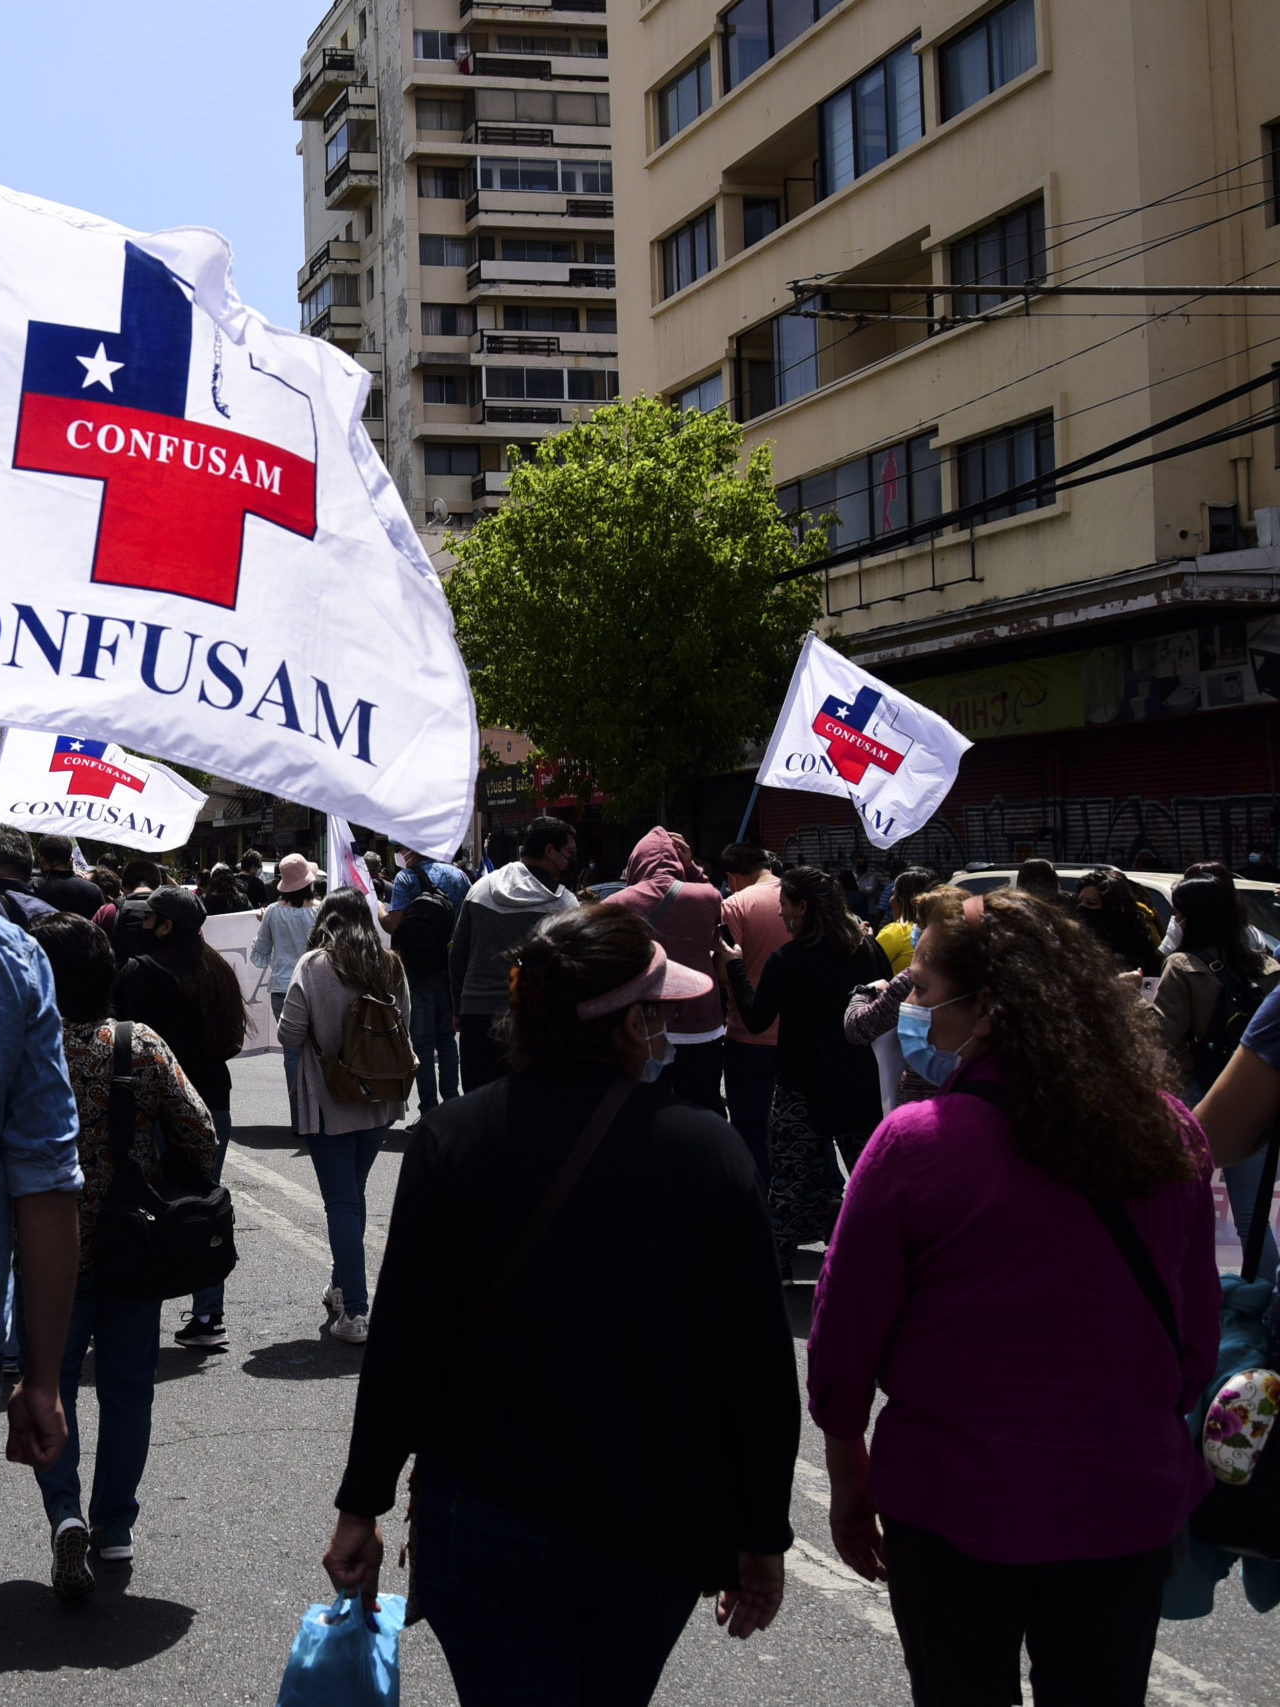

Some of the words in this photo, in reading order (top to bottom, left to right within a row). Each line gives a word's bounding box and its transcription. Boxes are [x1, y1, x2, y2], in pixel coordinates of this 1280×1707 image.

[66, 419, 283, 496] CONFUSAM
[824, 722, 890, 762] CONFUSAM
[63, 756, 132, 783] CONFUSAM
[9, 800, 167, 840] CONFUSAM
